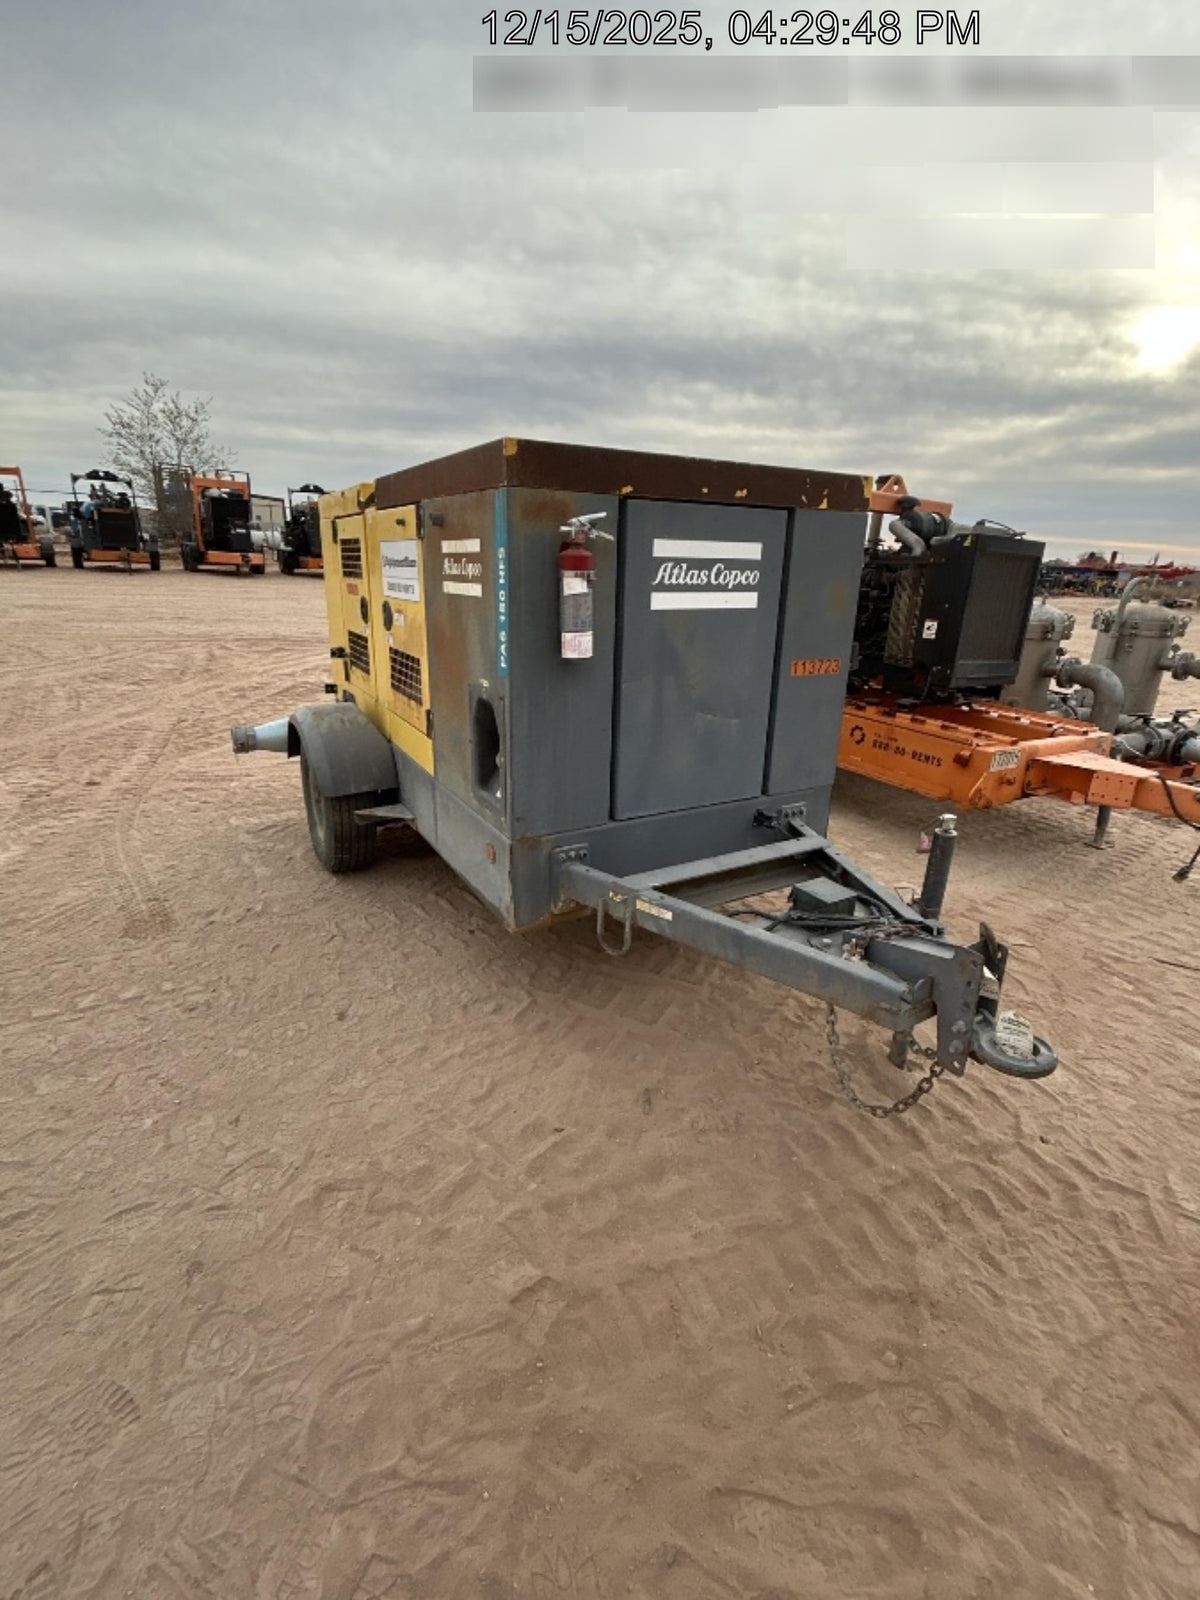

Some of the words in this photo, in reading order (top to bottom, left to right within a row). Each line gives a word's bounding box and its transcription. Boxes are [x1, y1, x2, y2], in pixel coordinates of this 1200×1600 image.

[652, 561, 709, 585] Atlas
[710, 563, 760, 589] Copco
[499, 630, 508, 669] PAS
